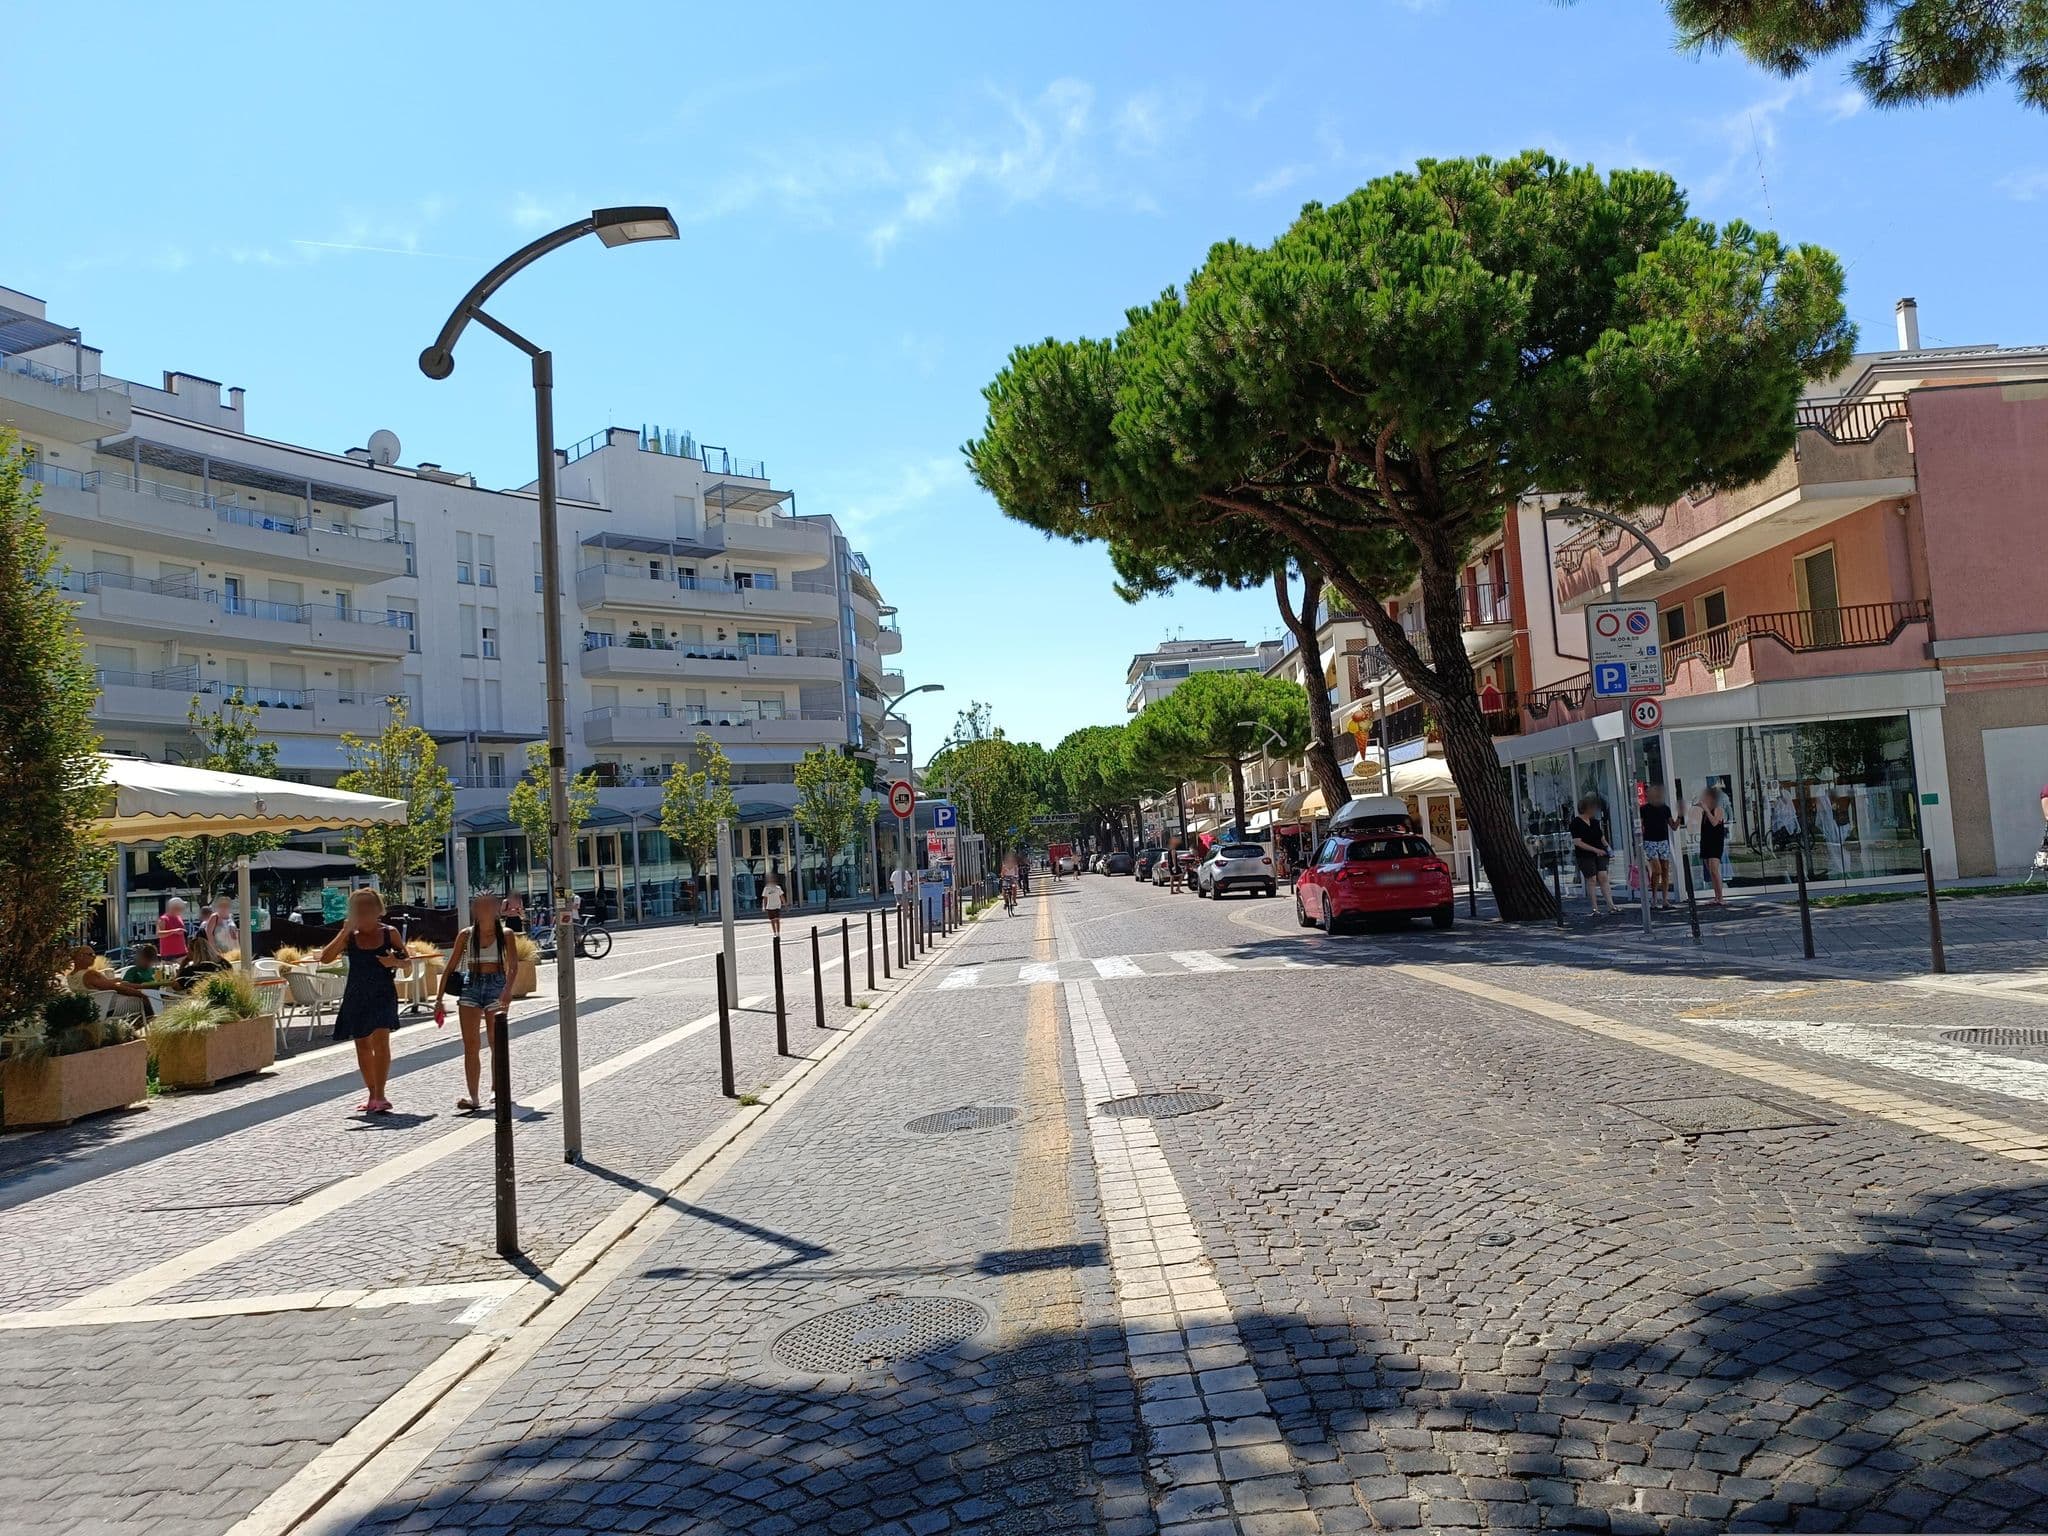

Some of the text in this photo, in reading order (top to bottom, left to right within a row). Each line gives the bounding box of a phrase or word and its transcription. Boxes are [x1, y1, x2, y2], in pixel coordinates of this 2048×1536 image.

[1602, 667, 1619, 690] P
[1637, 706, 1656, 720] 30
[938, 808, 952, 826] P
